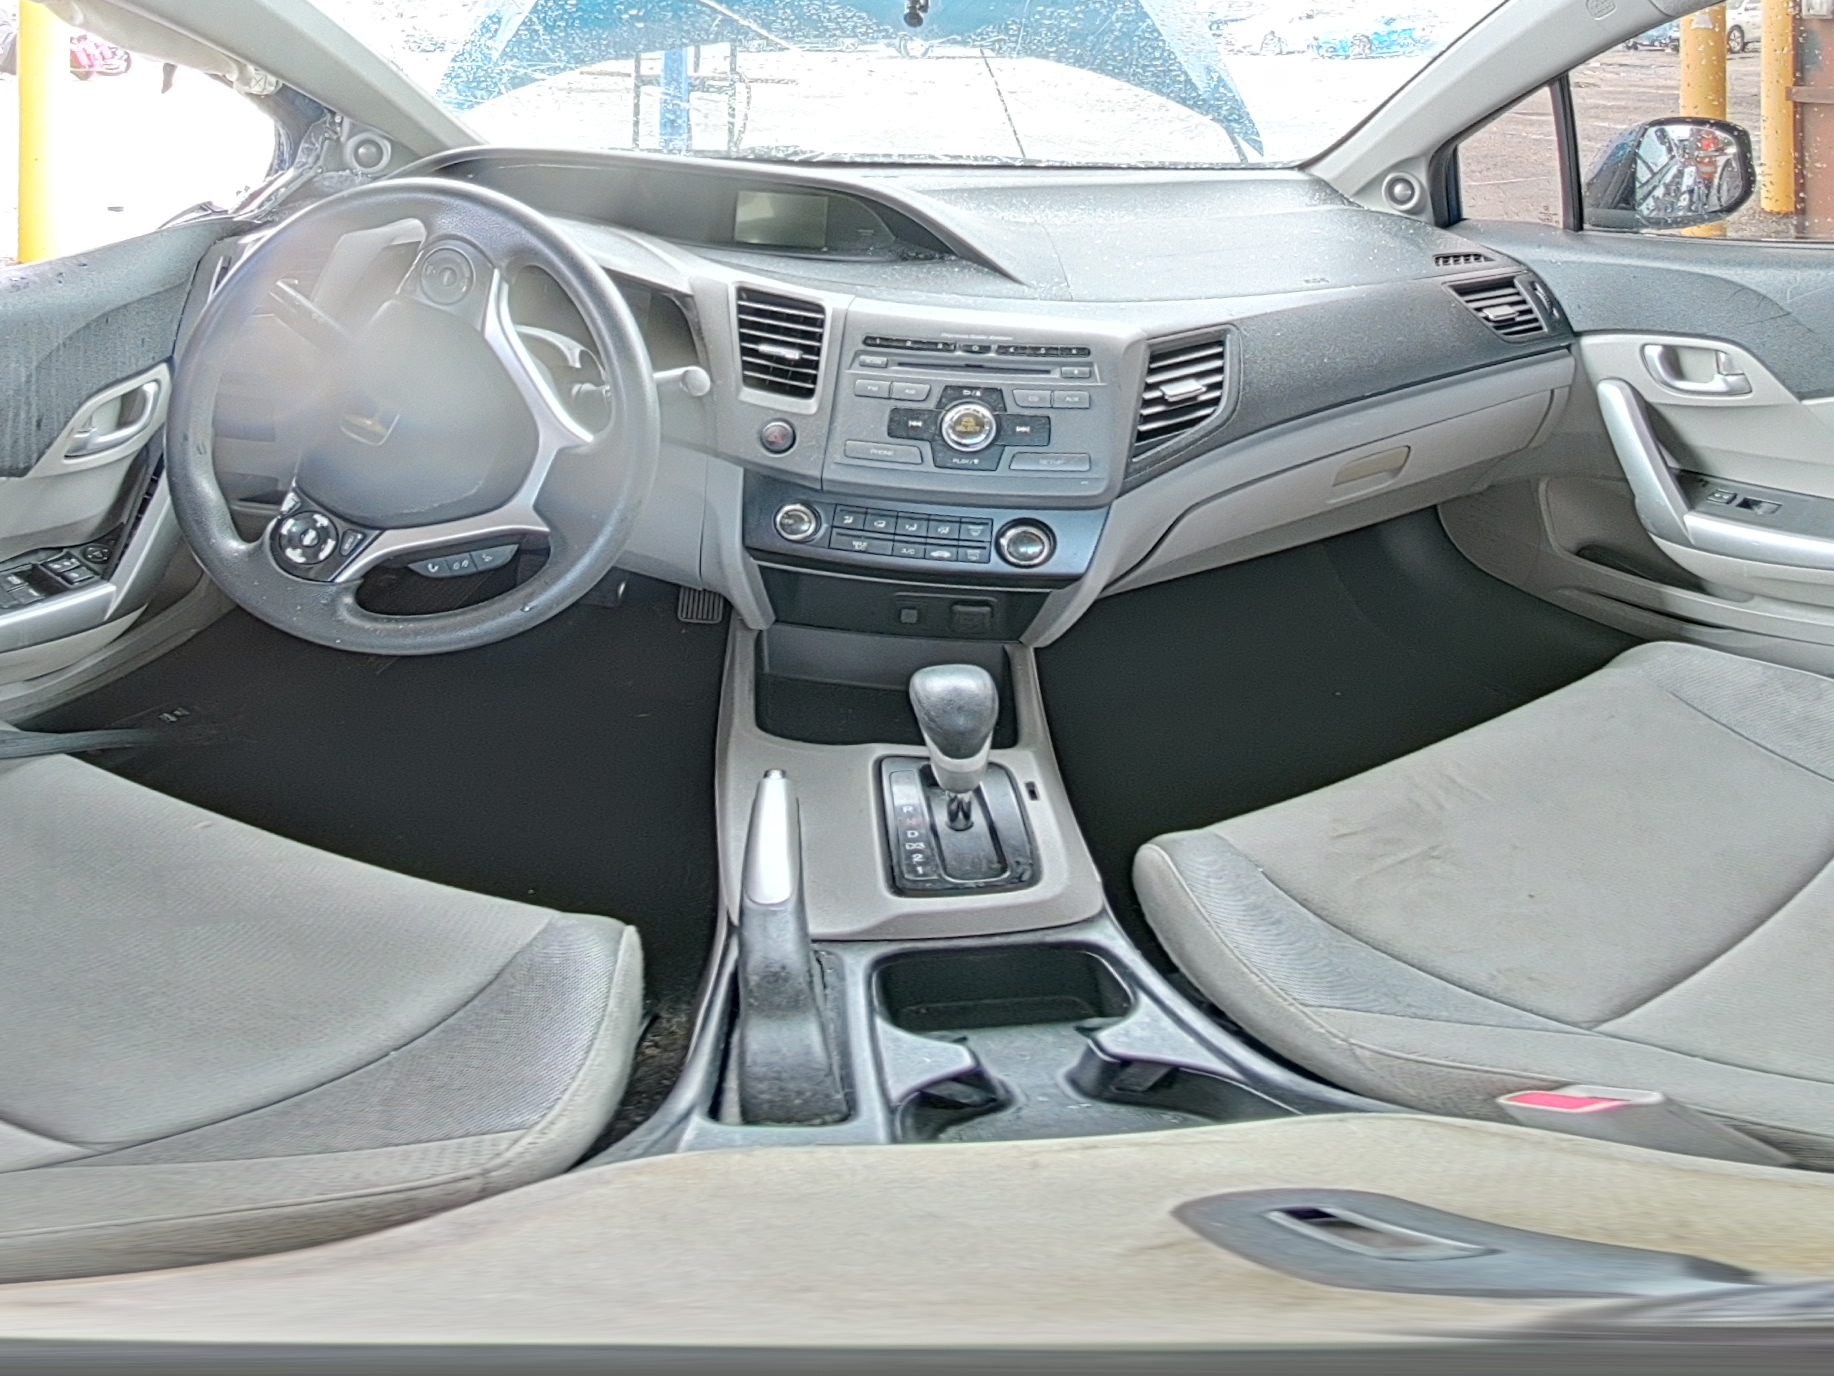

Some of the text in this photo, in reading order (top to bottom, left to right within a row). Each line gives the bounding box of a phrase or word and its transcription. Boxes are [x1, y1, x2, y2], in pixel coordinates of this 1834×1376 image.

[902, 805, 914, 813] R
[907, 830, 919, 838] D
[912, 853, 924, 862] 2
[916, 866, 923, 875] 1
